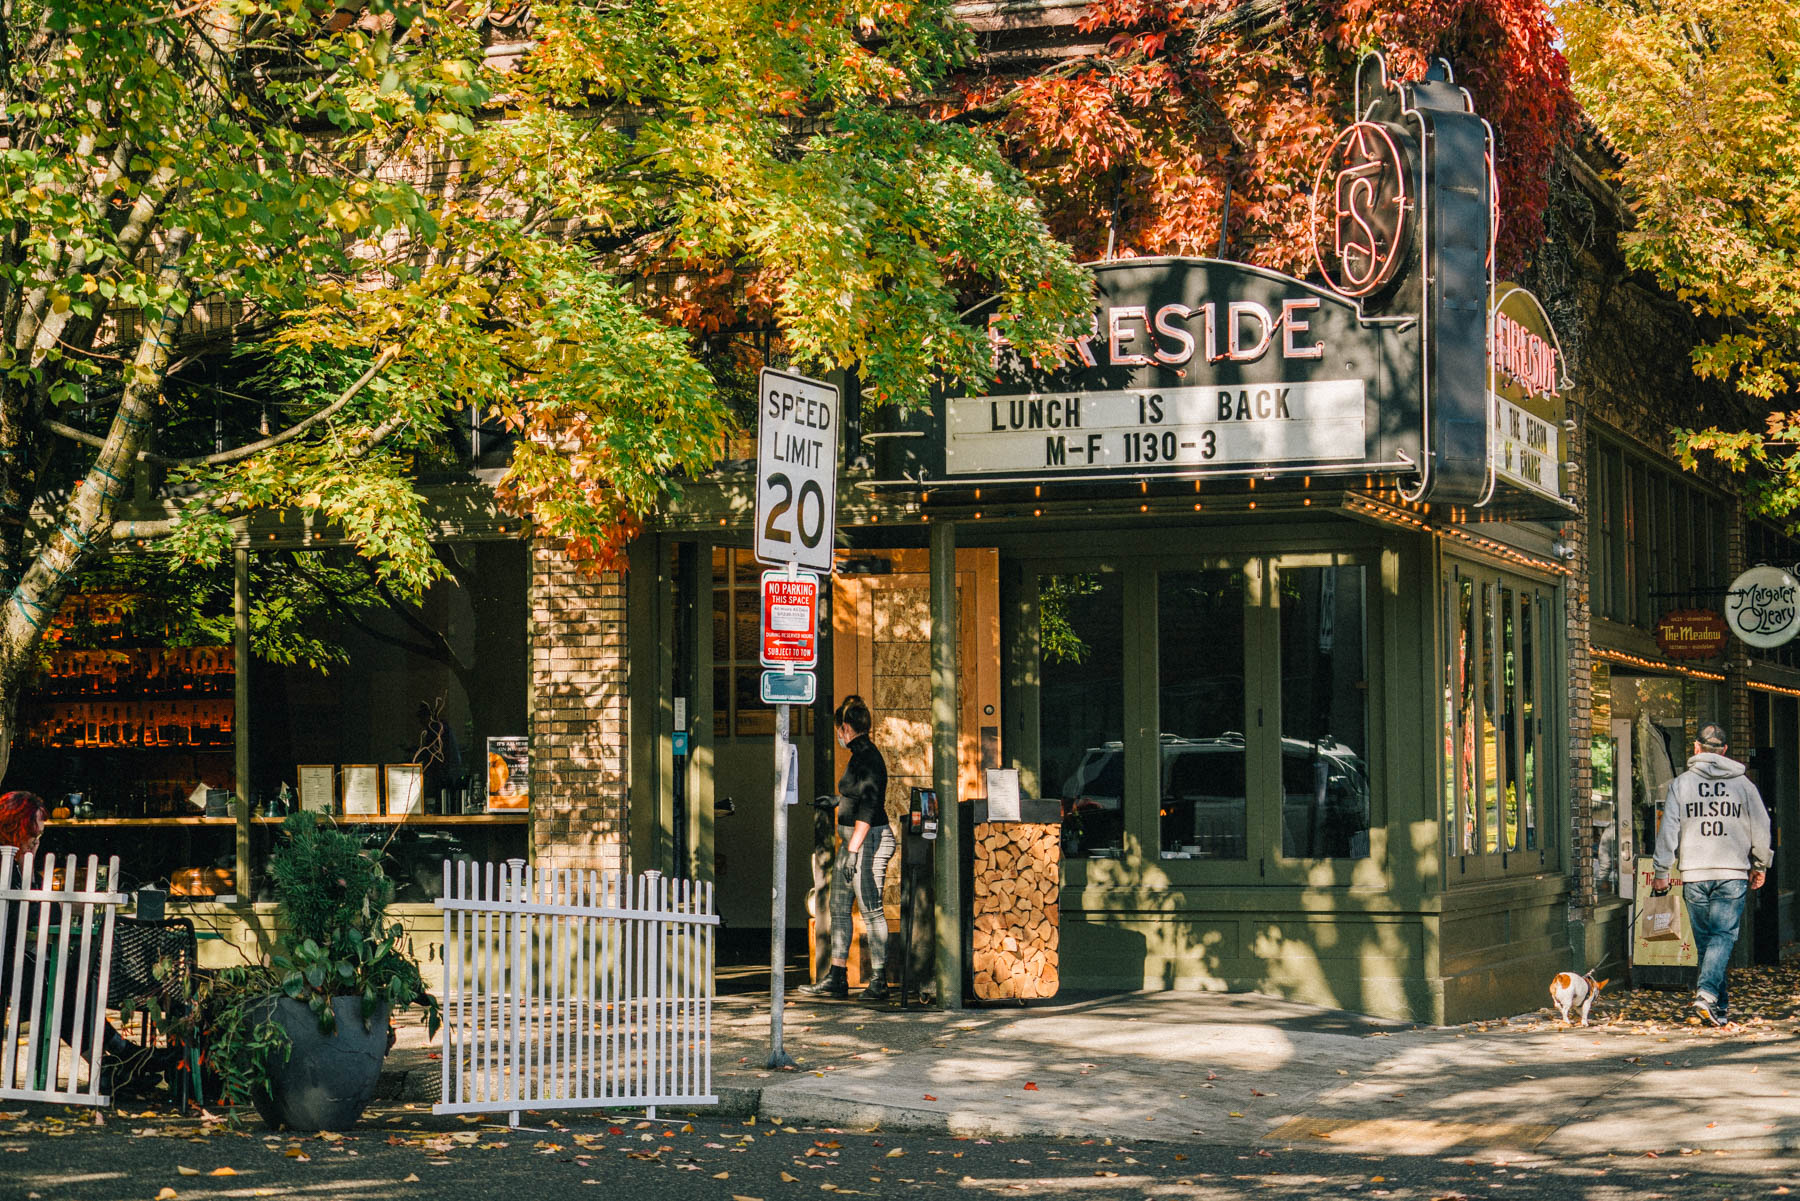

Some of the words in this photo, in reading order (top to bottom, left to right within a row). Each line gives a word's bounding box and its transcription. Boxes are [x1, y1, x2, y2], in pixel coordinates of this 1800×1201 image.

[768, 390, 831, 431] SPEED
[991, 397, 1081, 431] LUNCH
[1139, 394, 1164, 424] IS
[1217, 388, 1291, 421] BACK
[1509, 408, 1520, 441] THE
[773, 431, 823, 469] LIMIT
[1046, 434, 1102, 466] M-F
[1123, 430, 1217, 463] 1130-3
[764, 472, 825, 549] 20
[769, 583, 780, 594] NO
[782, 583, 813, 596] PARKING
[772, 595, 787, 604] THIS
[788, 595, 810, 605] SPACE
[1731, 583, 1796, 609] Margaret
[1660, 625, 1679, 641] The
[1680, 626, 1721, 641] Meadow
[767, 647, 792, 656] SUBJECT
[793, 648, 800, 656] TO
[800, 648, 812, 657] TOW
[1698, 782, 1729, 797] C.C.
[1685, 801, 1741, 818] FILSON
[1700, 820, 1728, 837] CO.
